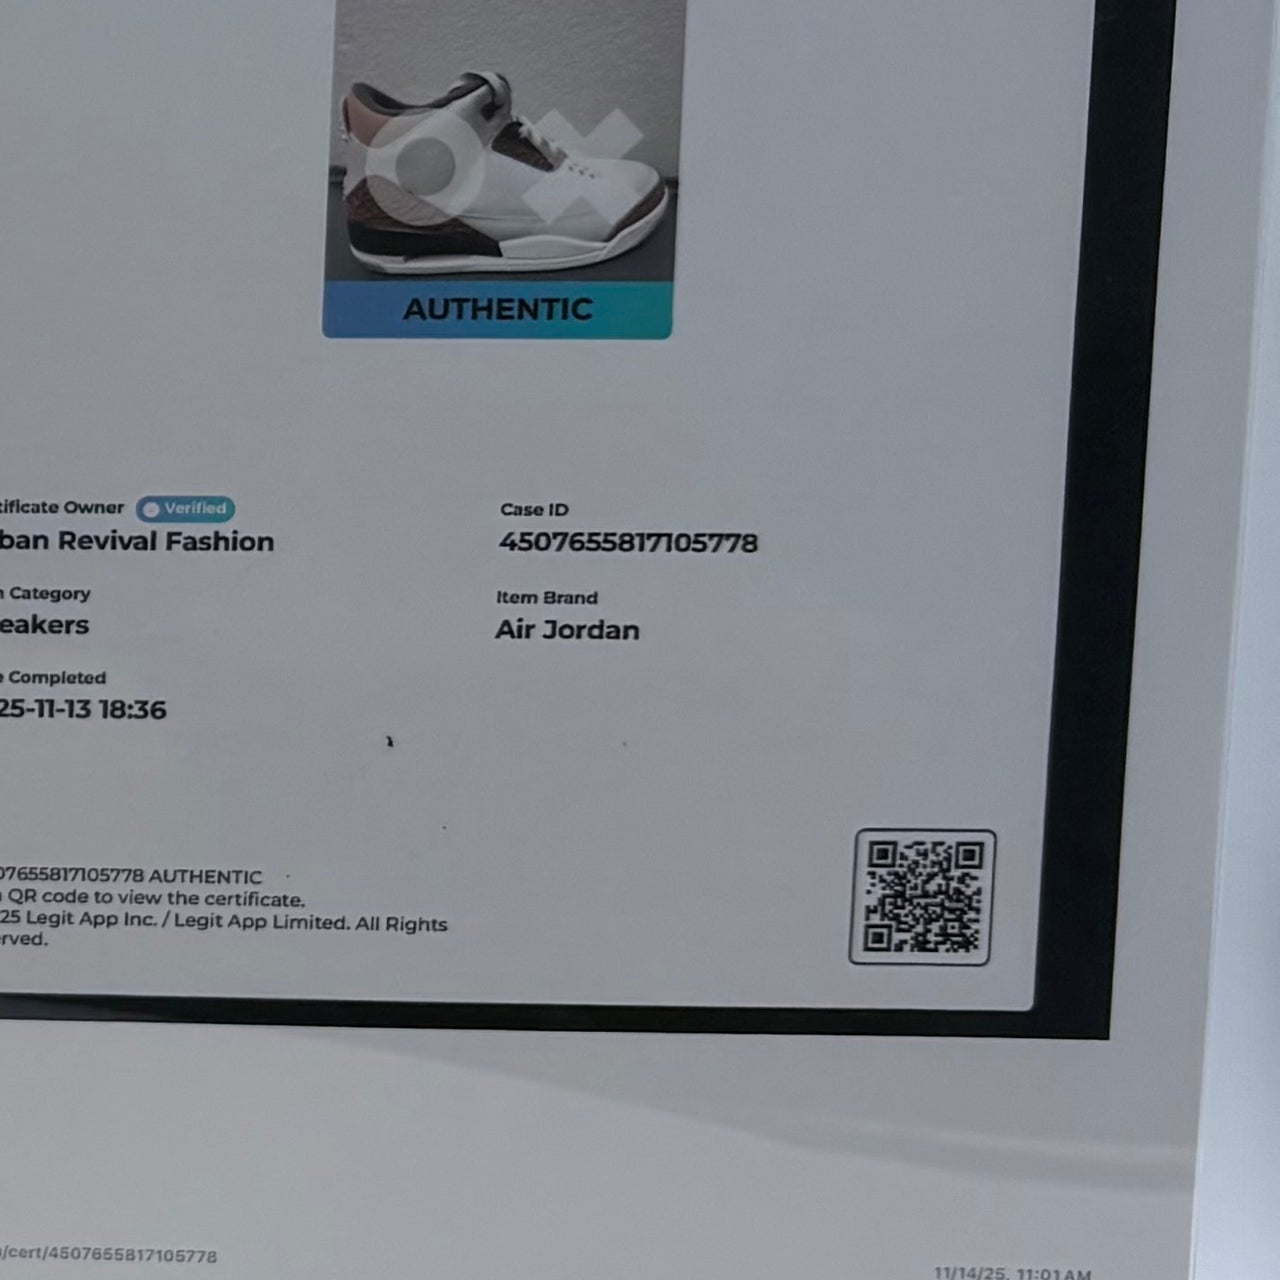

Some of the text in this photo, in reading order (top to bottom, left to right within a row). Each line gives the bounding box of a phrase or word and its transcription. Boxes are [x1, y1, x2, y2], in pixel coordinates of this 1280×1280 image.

[402, 296, 594, 322] AUTHENTIC
[63, 500, 126, 516] Owner
[164, 500, 227, 516] Verified
[500, 502, 570, 518] Case ID
[58, 528, 158, 552] Revival
[165, 529, 276, 553] Fashion
[498, 531, 759, 554] 4507655817105778
[9, 586, 92, 604] Category
[496, 589, 600, 606] Item Brand
[494, 616, 641, 642] Air Jordan
[8, 670, 108, 688] Completed
[98, 699, 168, 721] 18:36
[148, 869, 263, 885] AUTHENTIC
[7, 888, 37, 904] QR
[42, 888, 89, 904] code
[94, 890, 114, 905] to
[118, 889, 162, 906] view
[168, 891, 200, 907] the
[204, 891, 306, 908] certificate.
[26, 909, 75, 928] Legit
[79, 912, 119, 929] App
[124, 911, 159, 927] Inc.
[161, 909, 172, 928] /
[175, 912, 224, 931] Legit
[227, 914, 268, 932] App
[273, 914, 351, 931] Limited.
[355, 916, 381, 932] All
[385, 916, 449, 935] Rights
